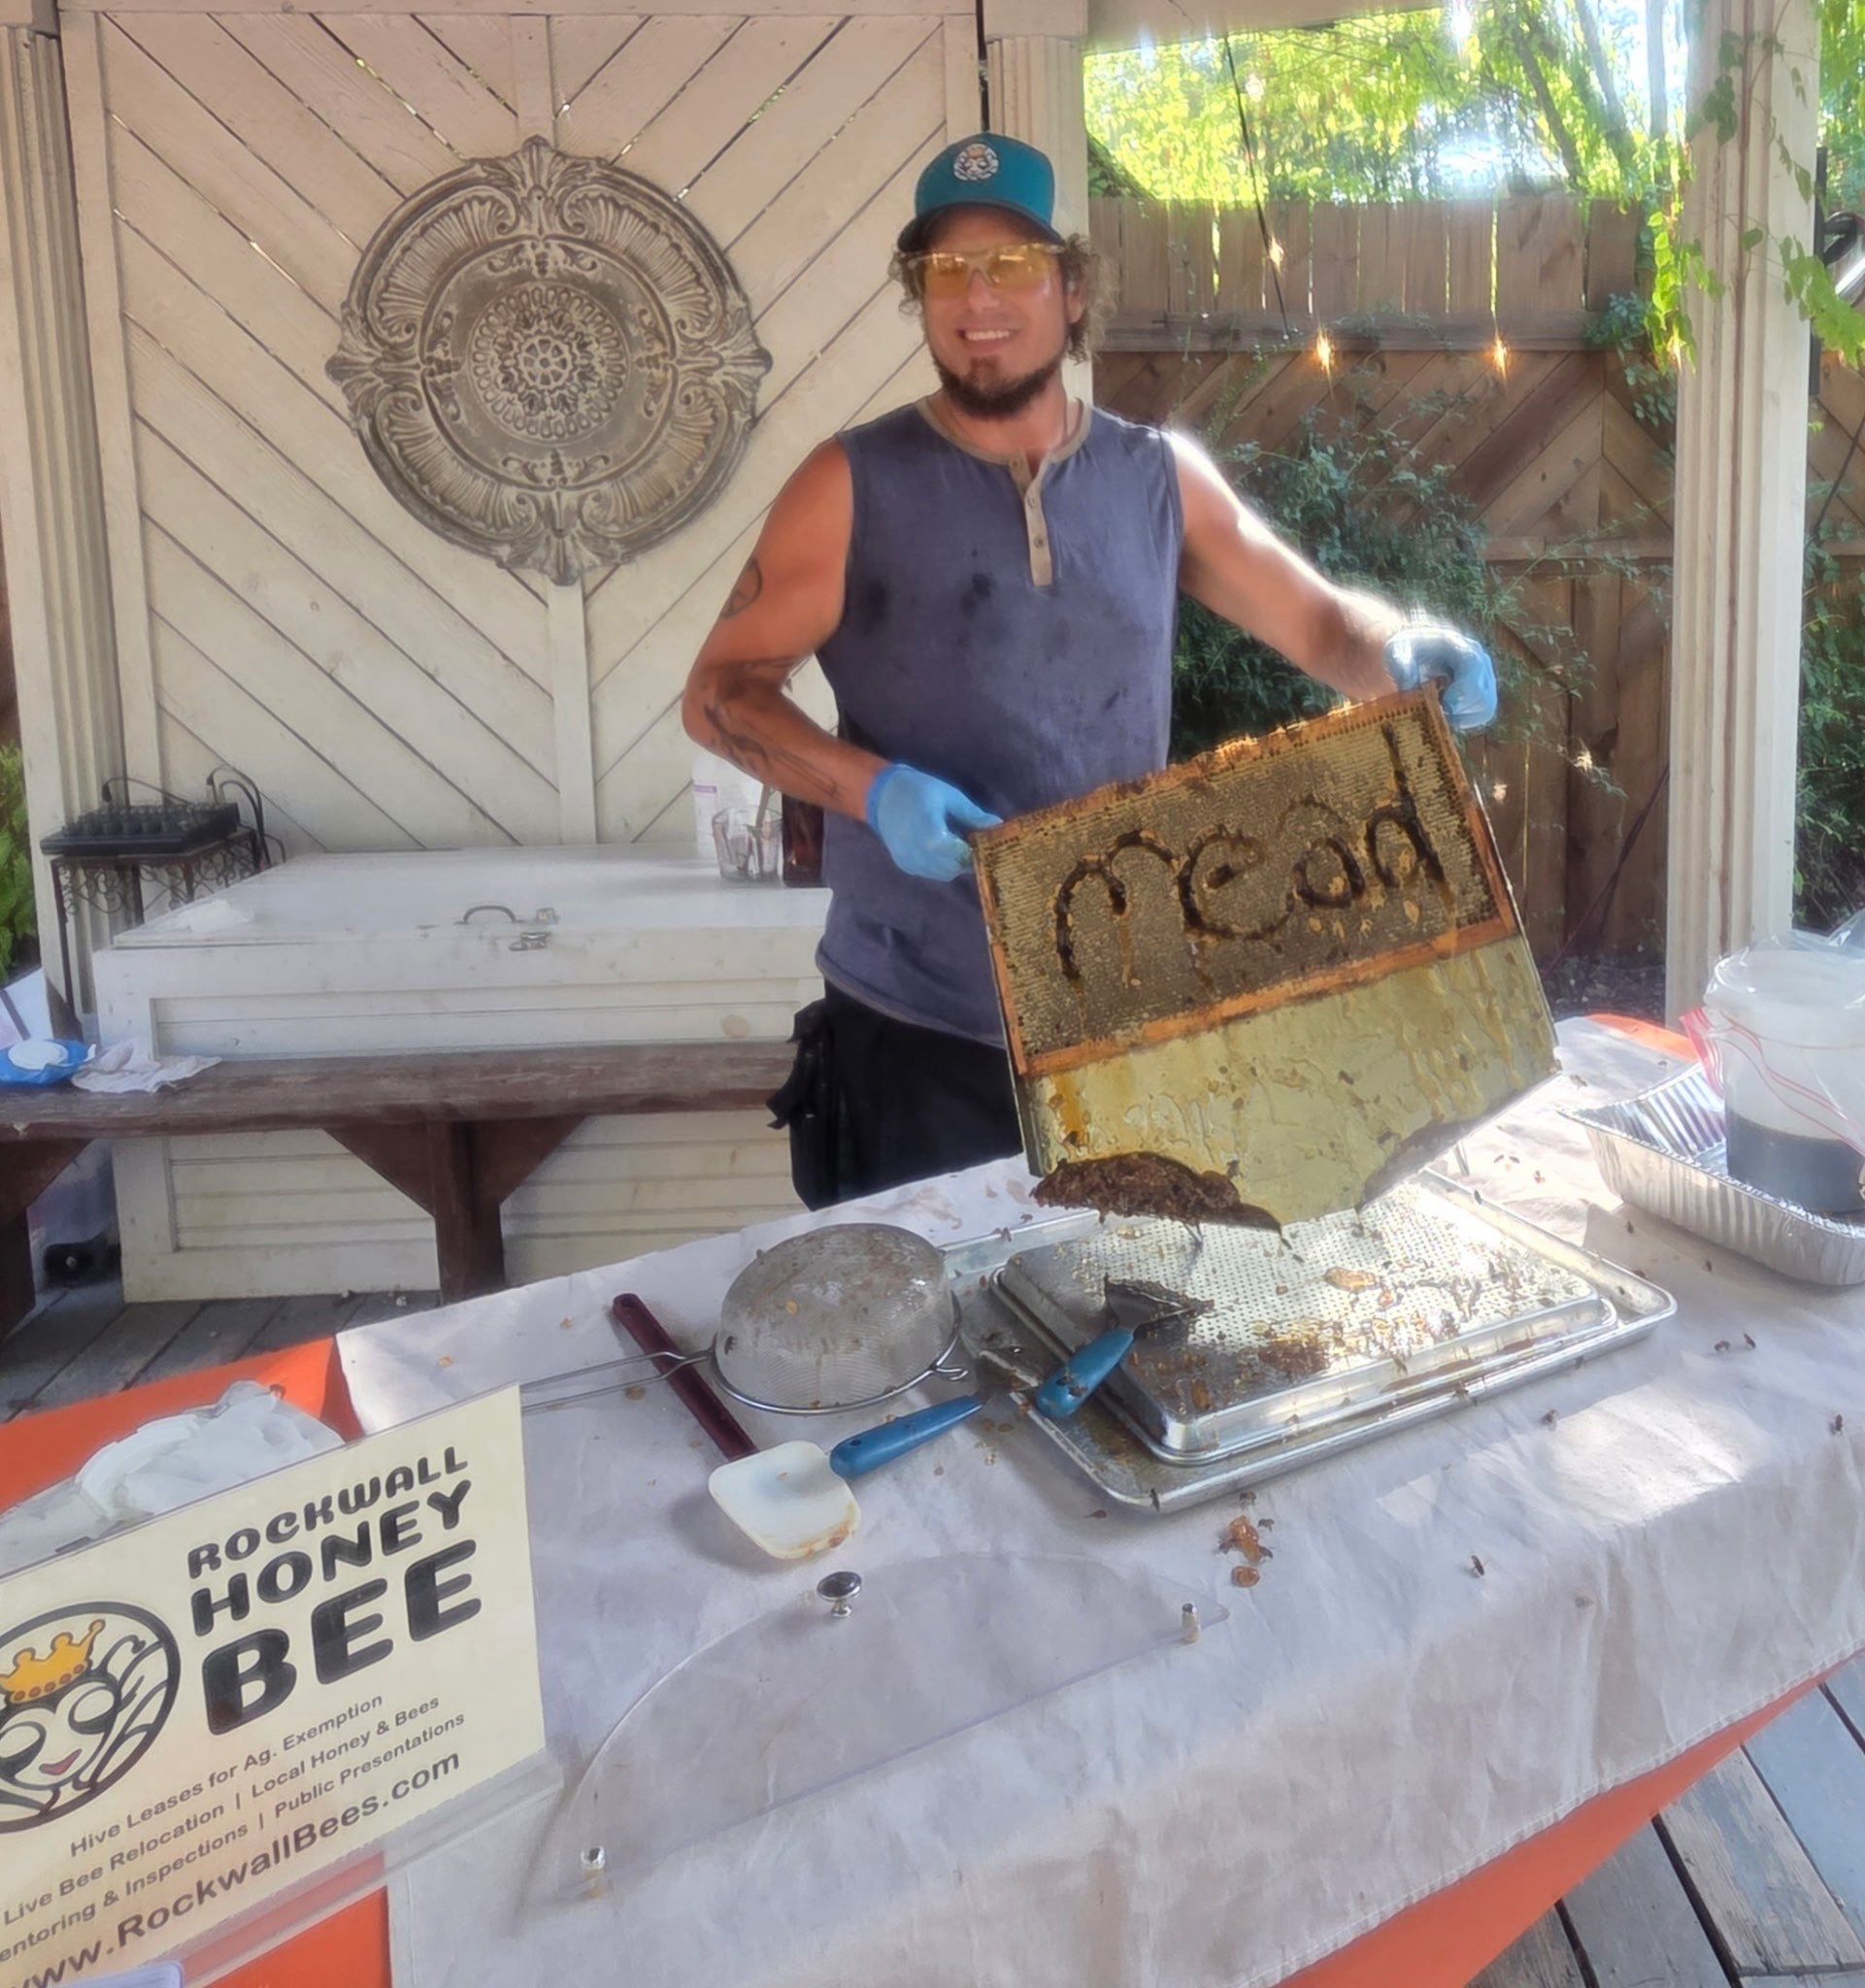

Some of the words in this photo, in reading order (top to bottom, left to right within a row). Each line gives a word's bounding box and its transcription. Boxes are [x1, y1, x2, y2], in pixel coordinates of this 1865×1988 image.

[1055, 721, 1450, 980] mead
[187, 1446, 468, 1579] ROCKWALL
[191, 1479, 471, 1637] HONEY
[202, 1540, 482, 1736] BEE
[4, 1893, 52, 1925] Live
[59, 1867, 103, 1897] Bee
[110, 1805, 224, 1871] Relocation
[252, 1761, 305, 1798] Local
[311, 1731, 370, 1769] Honey
[377, 1720, 390, 1735] &
[395, 1698, 439, 1726] Bees
[71, 1824, 120, 1857] Hive
[126, 1783, 203, 1828] Leases
[208, 1765, 238, 1787] for
[244, 1749, 277, 1771] Ag.
[283, 1696, 383, 1751] Exemption
[103, 1890, 119, 1906] &
[126, 1824, 248, 1896] Inspections
[275, 1780, 334, 1818] Public
[340, 1713, 465, 1785] Presentations
